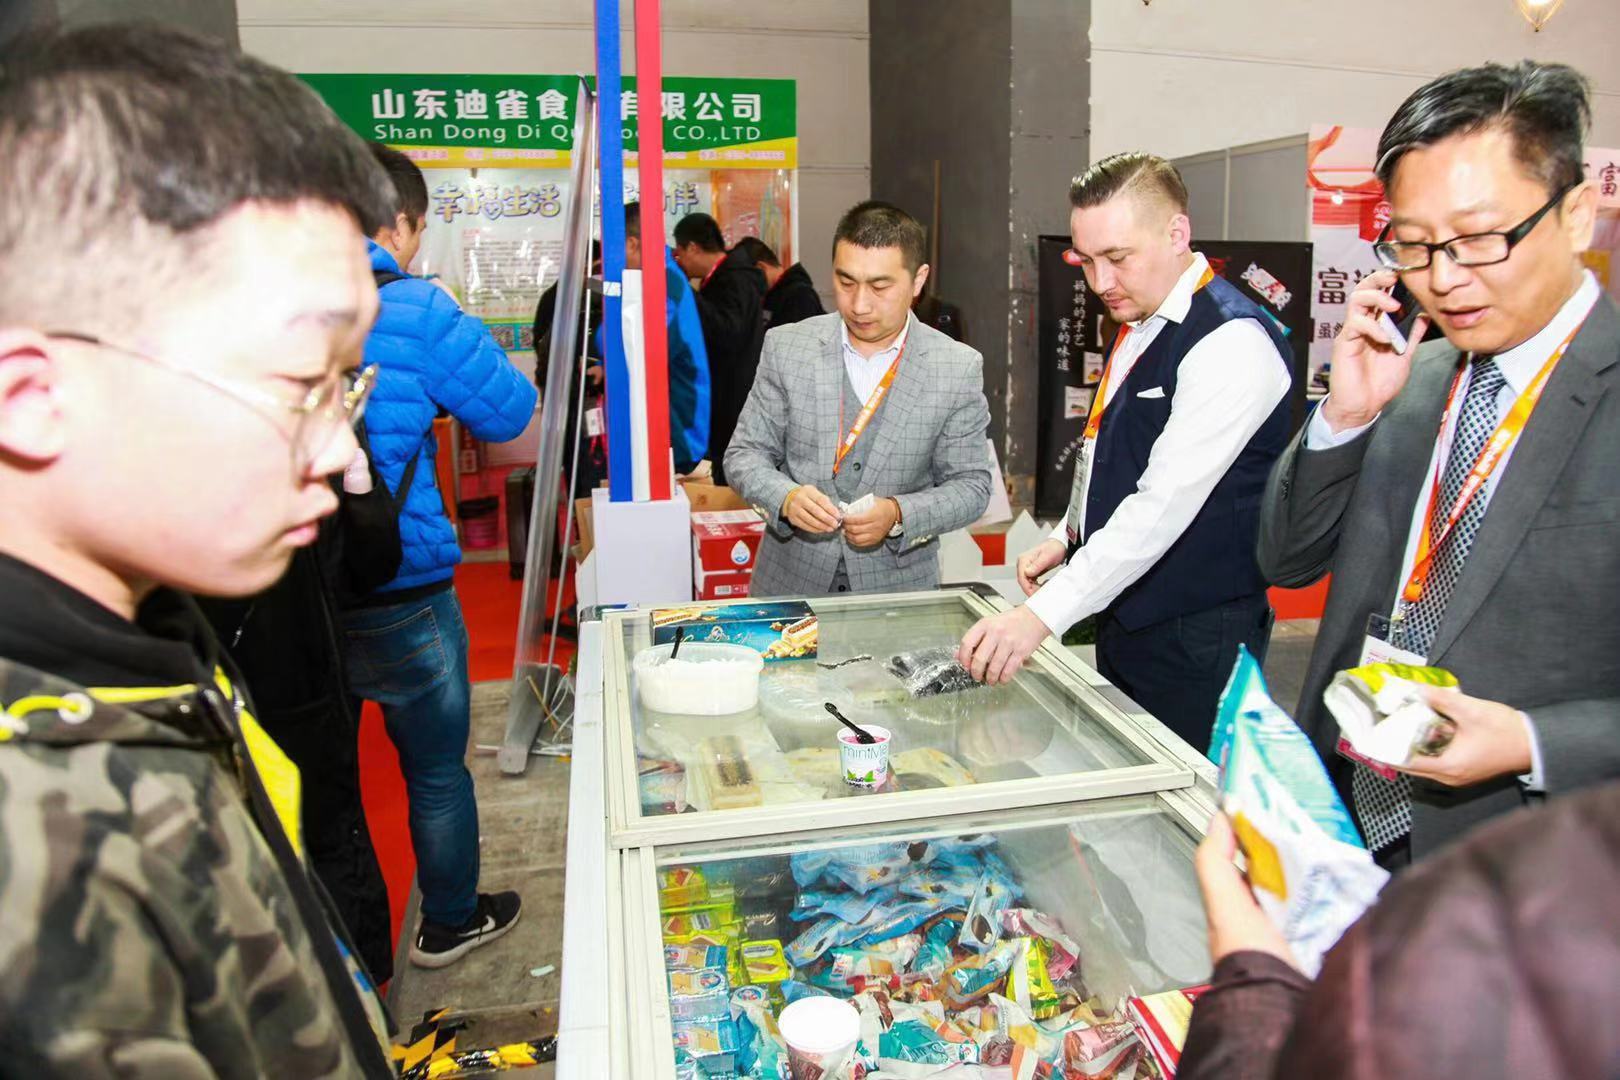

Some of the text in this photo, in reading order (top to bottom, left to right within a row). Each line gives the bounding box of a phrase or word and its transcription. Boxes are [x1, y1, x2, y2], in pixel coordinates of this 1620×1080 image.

[374, 124, 432, 140] Shan
[444, 125, 506, 142] Dong
[518, 125, 540, 138] Di
[673, 126, 760, 141] CO.,LTD
